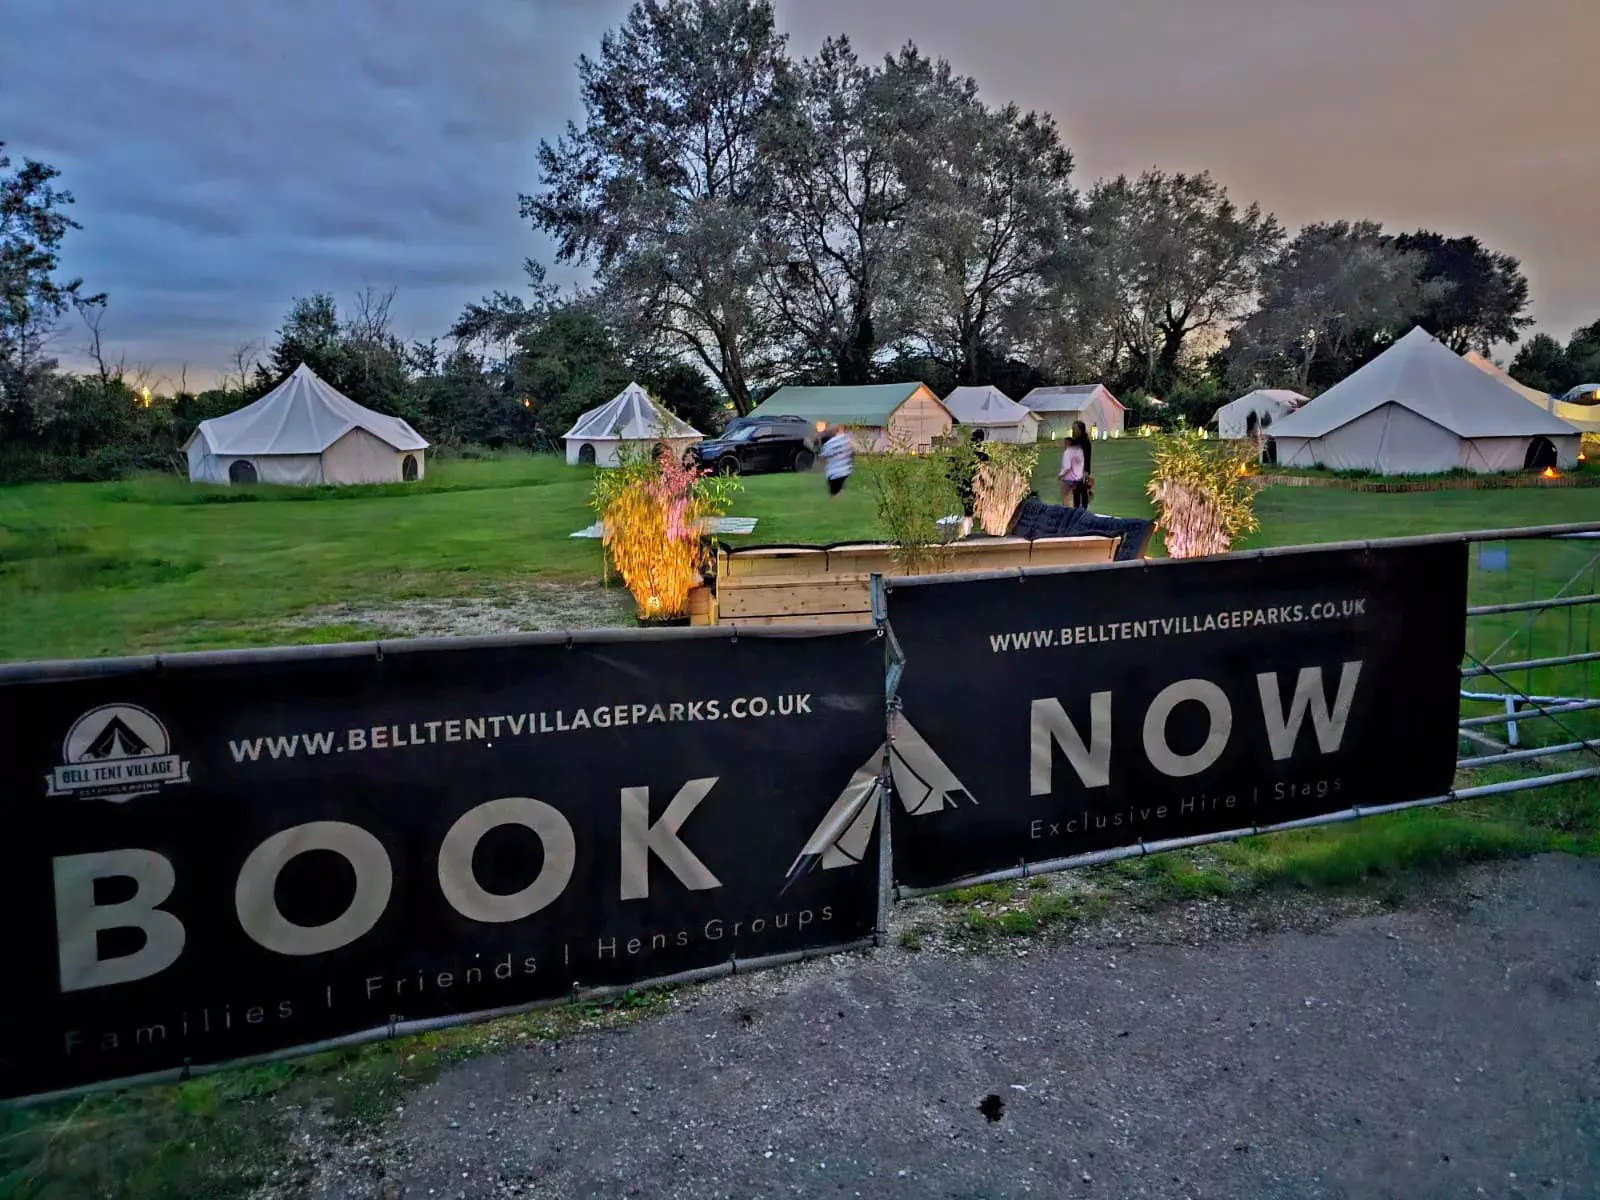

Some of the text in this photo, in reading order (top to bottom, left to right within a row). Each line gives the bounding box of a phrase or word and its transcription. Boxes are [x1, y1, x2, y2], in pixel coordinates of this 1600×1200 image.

[989, 598, 1367, 653] WWW.BELLTENTVILLAGEPARKS.CO.UK
[228, 694, 813, 763] WWW.BELLTENTVILLAGEPARKS.CO.UK
[1029, 660, 1364, 797] NOW
[61, 760, 175, 784] BELL TENT VILLAGE
[1030, 801, 1169, 840] Exclusive
[1180, 793, 1237, 815] Hire
[1274, 776, 1343, 801] Stags
[52, 776, 724, 993] BOOK
[63, 1000, 293, 1056] Families
[366, 953, 538, 1000] Friends
[598, 929, 690, 960] Hens
[704, 905, 834, 941] Groups
